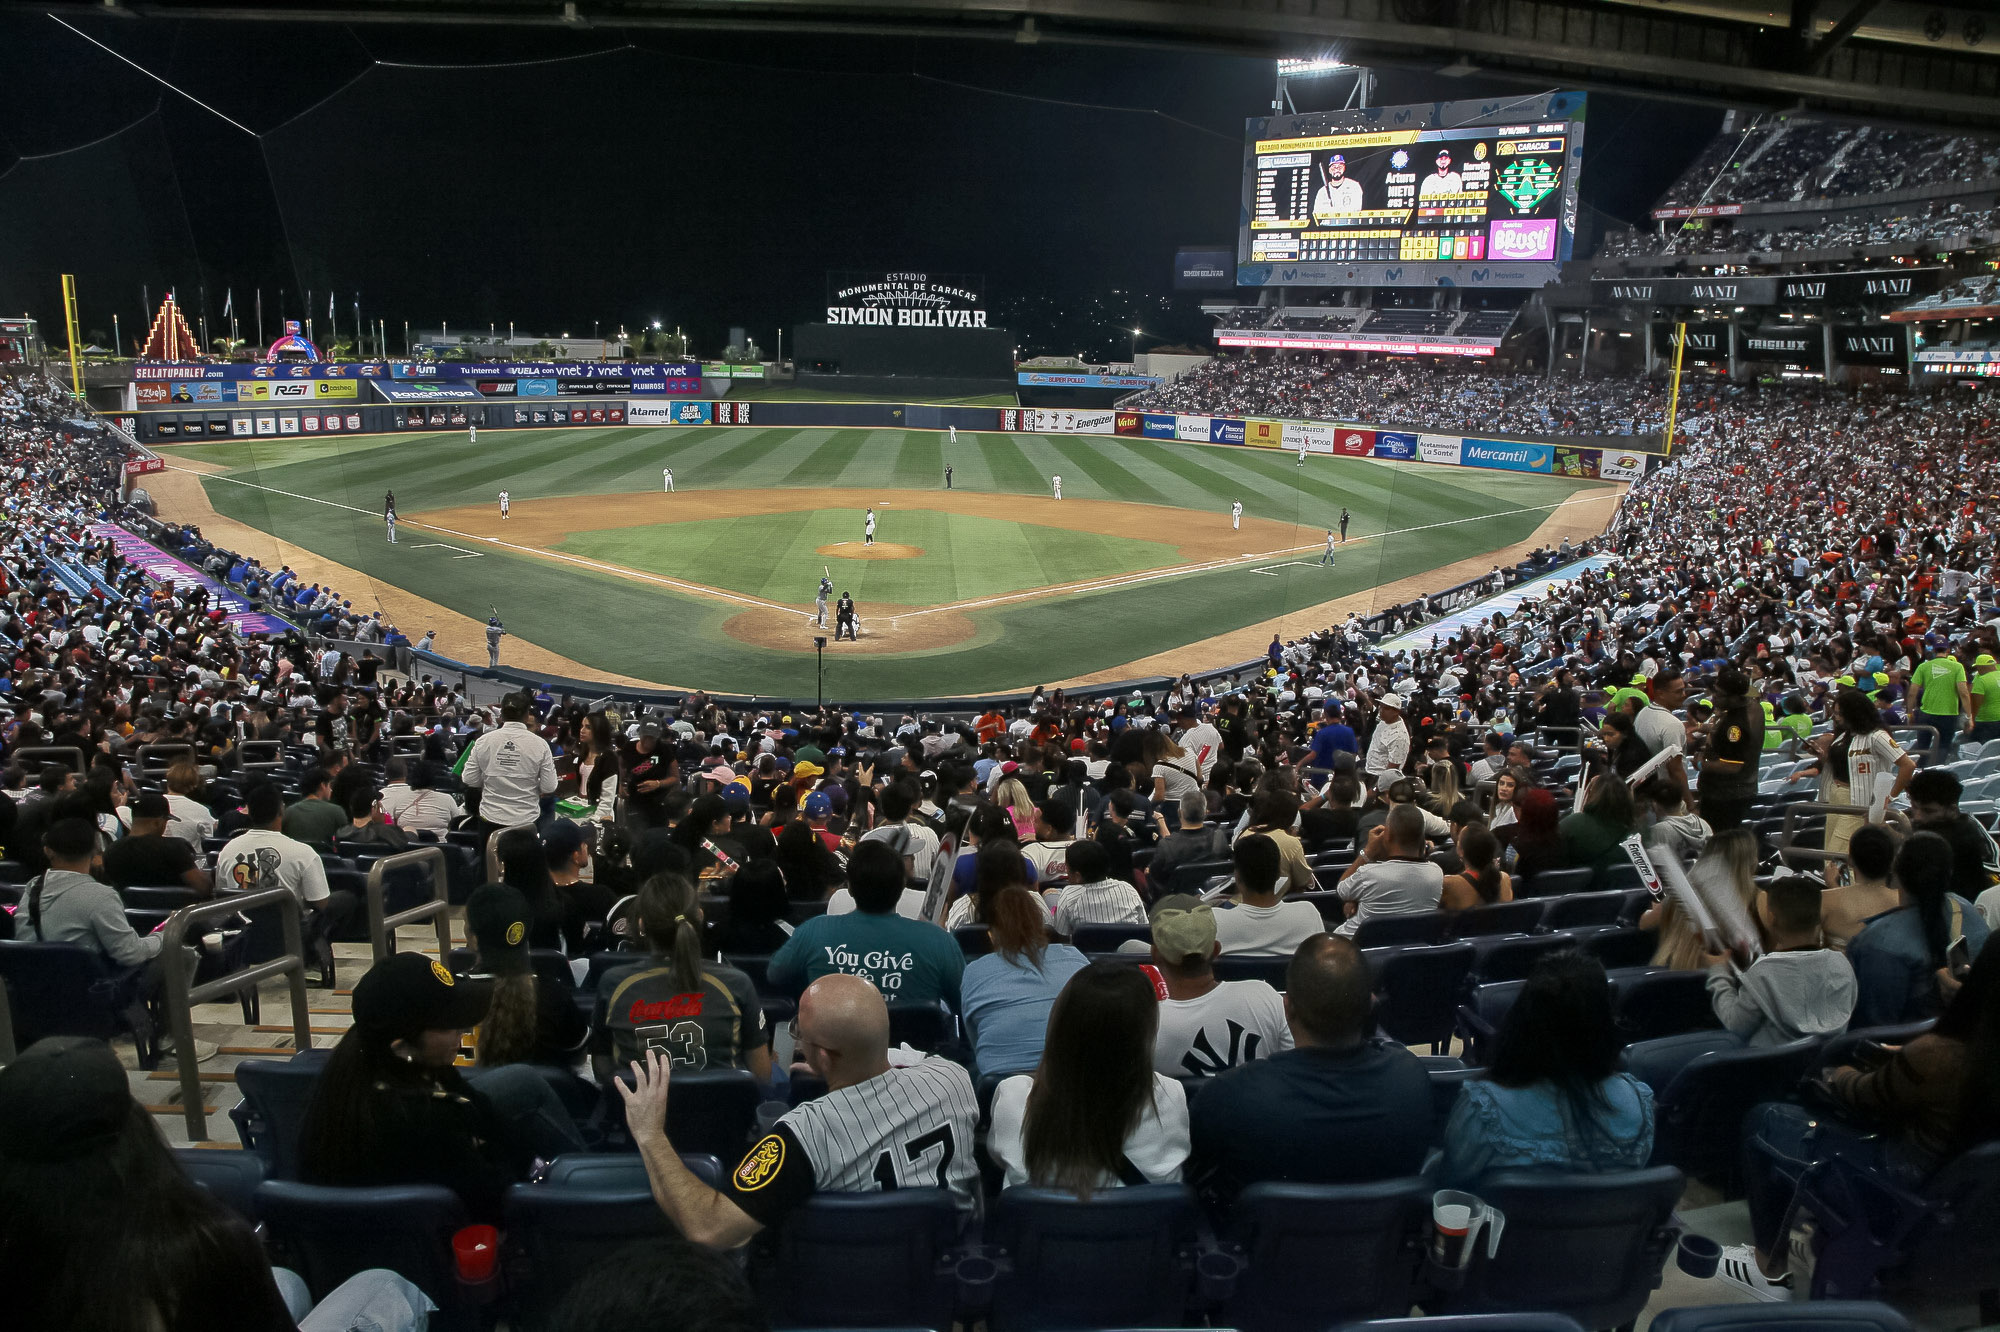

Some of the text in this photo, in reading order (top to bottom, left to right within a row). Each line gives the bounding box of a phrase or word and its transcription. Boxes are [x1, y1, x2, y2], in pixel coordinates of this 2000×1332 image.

[1258, 135, 1392, 152] ESTADIO MONUMENTAL DE CARACAS SIMÓN BOLÍVAR
[1518, 142, 1550, 151] CARACAS
[1386, 172, 1416, 184] Arturo
[1388, 185, 1415, 198] NIETO
[1442, 241, 1450, 256] 0
[1456, 241, 1465, 256] 0
[1472, 241, 1479, 256] 1
[886, 273, 927, 282] ESTADIO
[838, 283, 909, 298] MONUMENTAL
[931, 284, 977, 302] CARACAS
[1611, 286, 1652, 298] AVANTI
[1691, 285, 1737, 298] AVANTI
[1784, 282, 1826, 297] AVANTI
[1863, 278, 1912, 294] AVANTI
[826, 302, 987, 328] SIMÓN BOLÍVAR
[1668, 334, 1716, 348] AVANTI
[1748, 339, 1806, 351] FRIGILUX
[1846, 337, 1894, 352] AVANTI
[136, 367, 224, 379] SELLATUPARLEY.com
[512, 367, 540, 375] VUELA
[556, 365, 582, 376] vnet
[598, 366, 622, 376] vnet
[631, 366, 655, 376] vnet
[663, 366, 687, 376] vnet
[630, 408, 668, 416] Atamel
[682, 405, 699, 413] CLUB
[1076, 415, 1113, 429] Energizer
[1152, 422, 1174, 430] Bancamiga
[1179, 424, 1208, 433] La Santé
[1282, 436, 1303, 444] UNDER
[1420, 442, 1459, 450] Acetaminofén
[1468, 447, 1527, 463] Mercantil
[1858, 762, 1871, 774] 21
[1628, 843, 1652, 876] Energizer
[824, 944, 913, 970] You Give
[881, 972, 901, 989] to
[629, 992, 705, 1024] Coca-Cola
[635, 1021, 707, 1072] 53
[871, 1119, 955, 1192] 17
